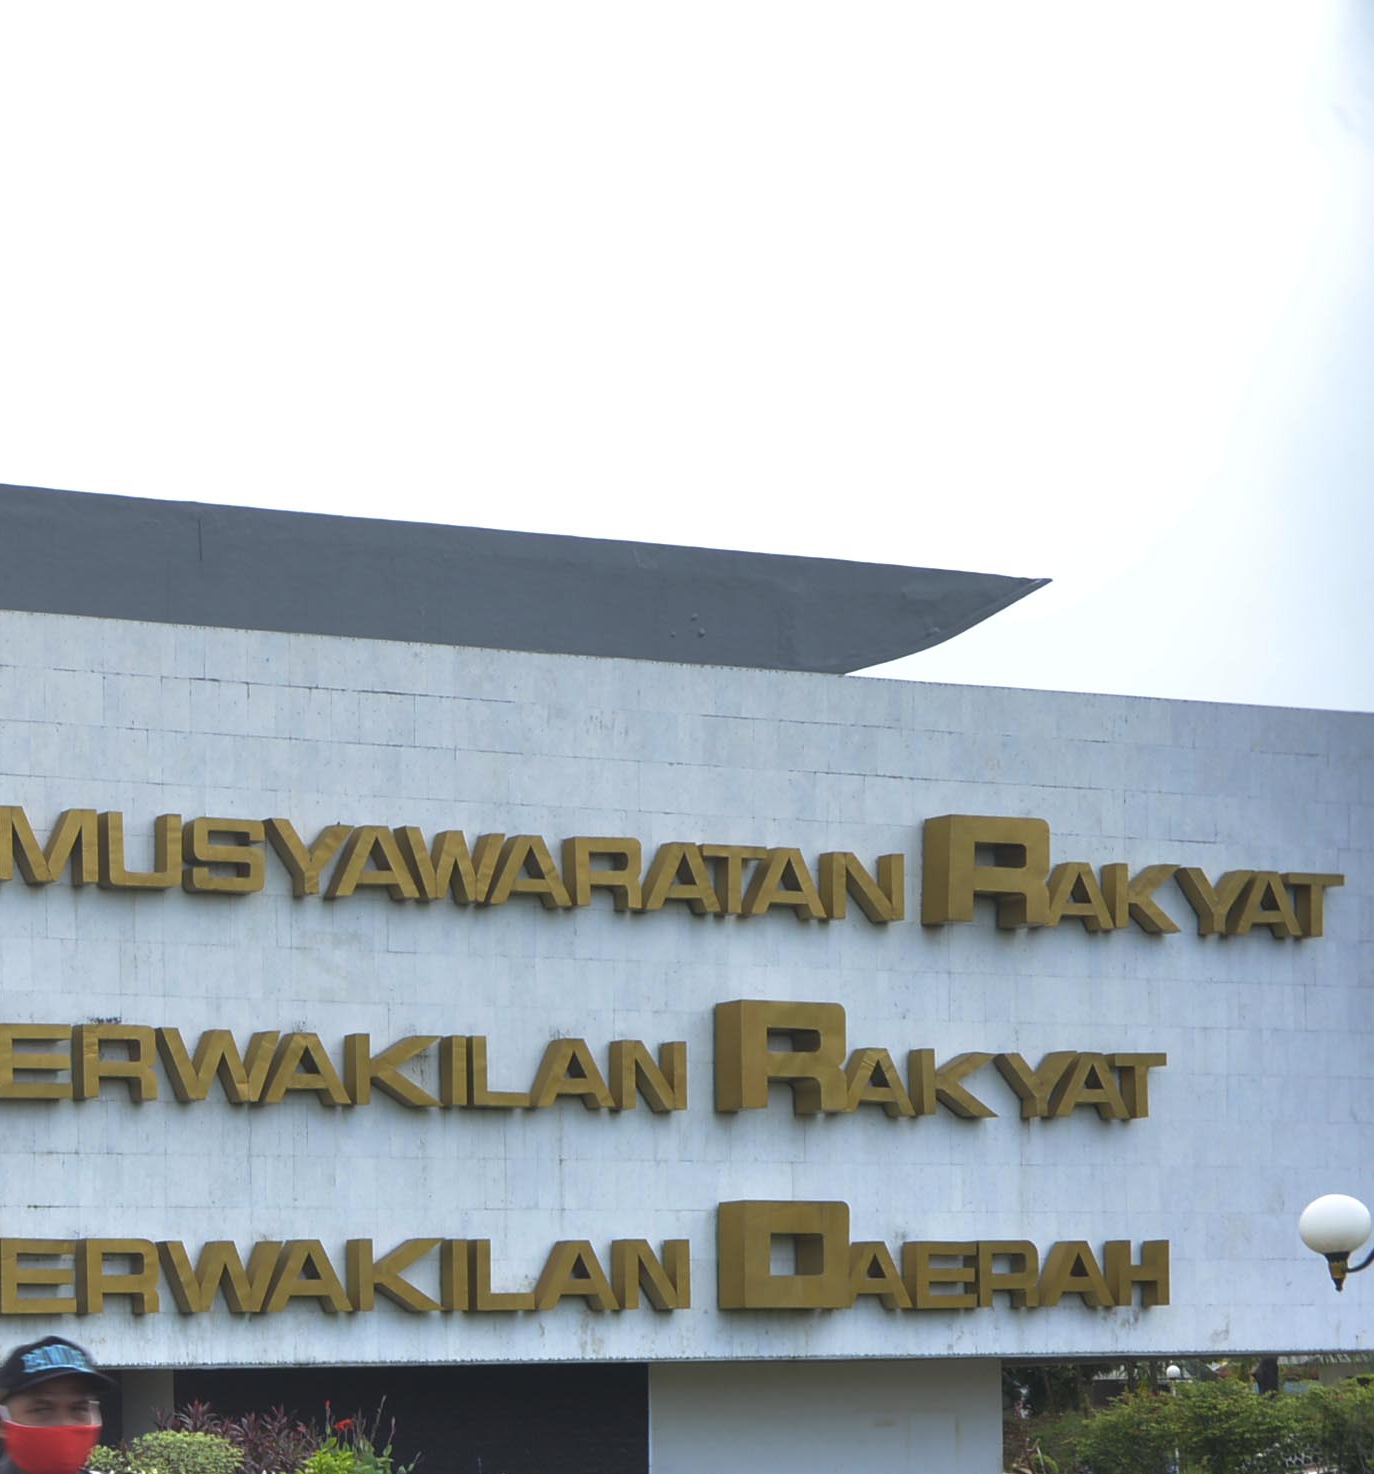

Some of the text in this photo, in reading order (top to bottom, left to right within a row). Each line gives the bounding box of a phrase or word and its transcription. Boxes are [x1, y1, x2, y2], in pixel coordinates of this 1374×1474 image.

[922, 814, 1344, 938] RAKYAT
[714, 1000, 1167, 1120] RAKYAT
[716, 1200, 1170, 1311] DAERAH
